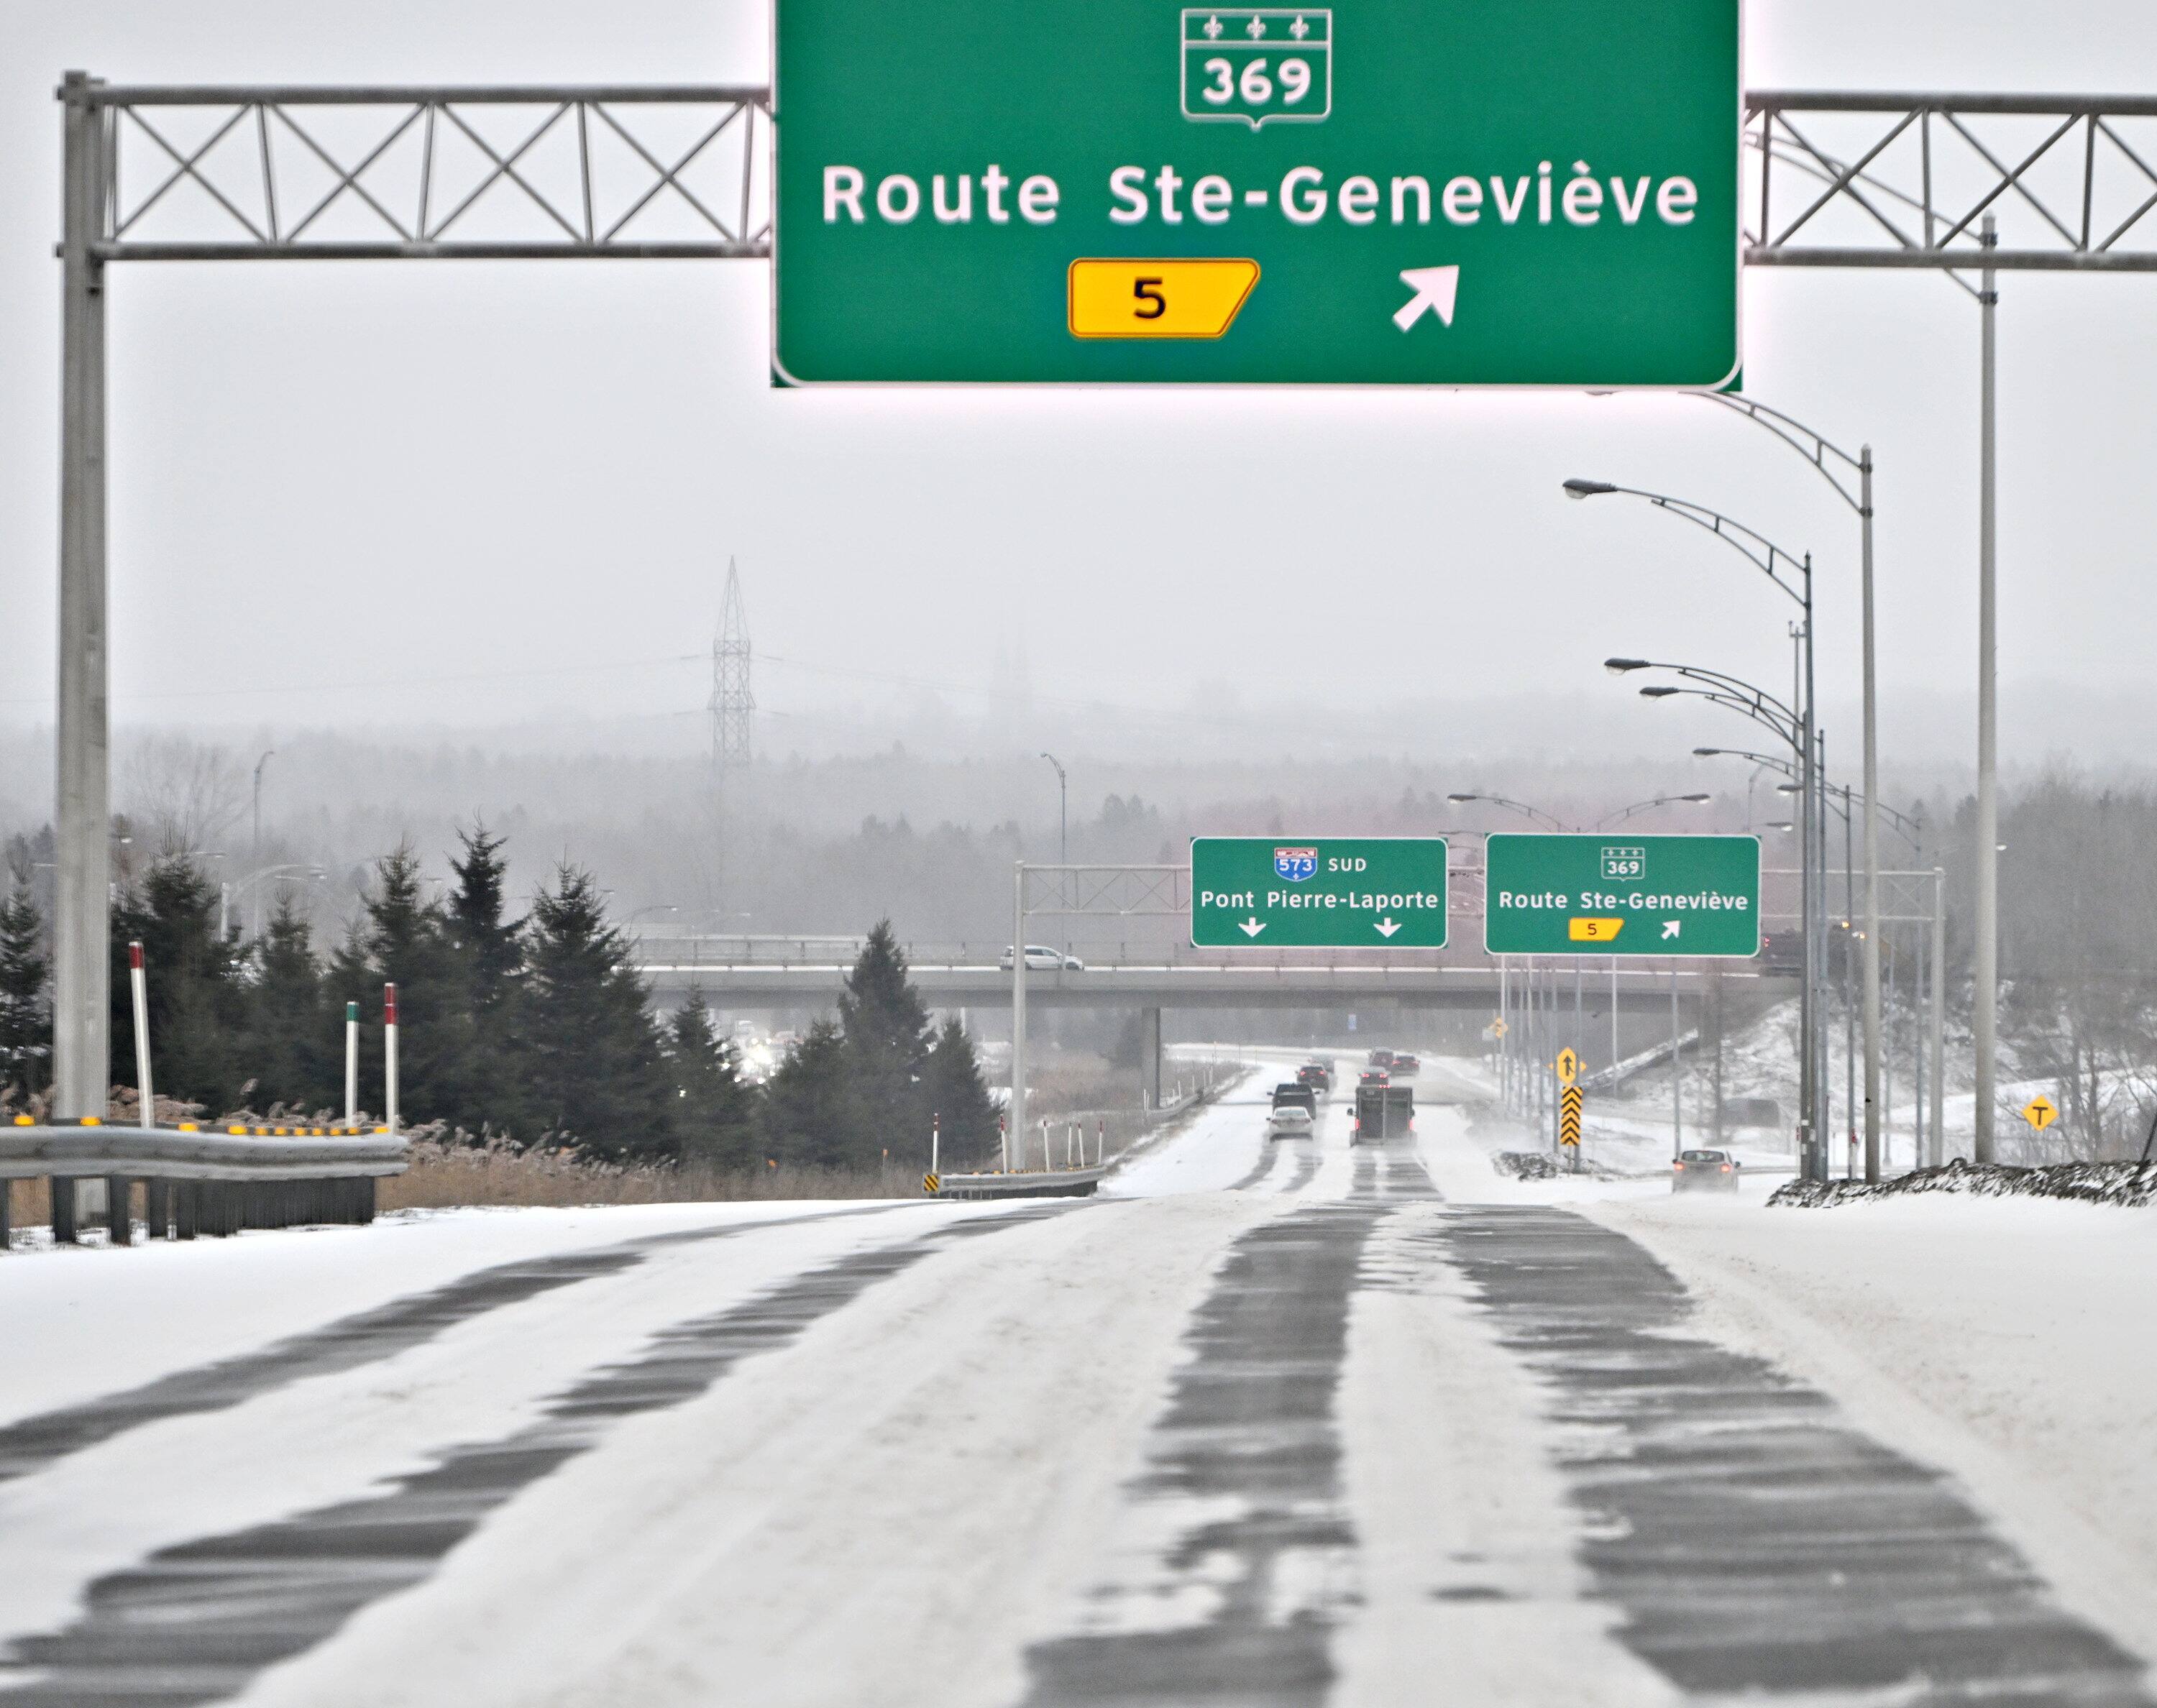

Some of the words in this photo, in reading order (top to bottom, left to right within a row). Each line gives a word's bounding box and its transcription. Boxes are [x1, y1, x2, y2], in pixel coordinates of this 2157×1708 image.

[1202, 57, 1311, 104] 369
[823, 164, 1061, 224] Route
[1109, 160, 1698, 225] Ste-Geneviève
[1133, 278, 1167, 321] 5
[1279, 858, 1313, 871] 573
[1328, 858, 1367, 872] SUD
[1607, 860, 1640, 875] 369
[1201, 891, 1254, 909] Pont
[1268, 889, 1438, 913] Pierre-Laporte
[1499, 891, 1568, 909] Route
[1580, 891, 1749, 910] Ste-Geneviève
[1587, 923, 1598, 935] 5
